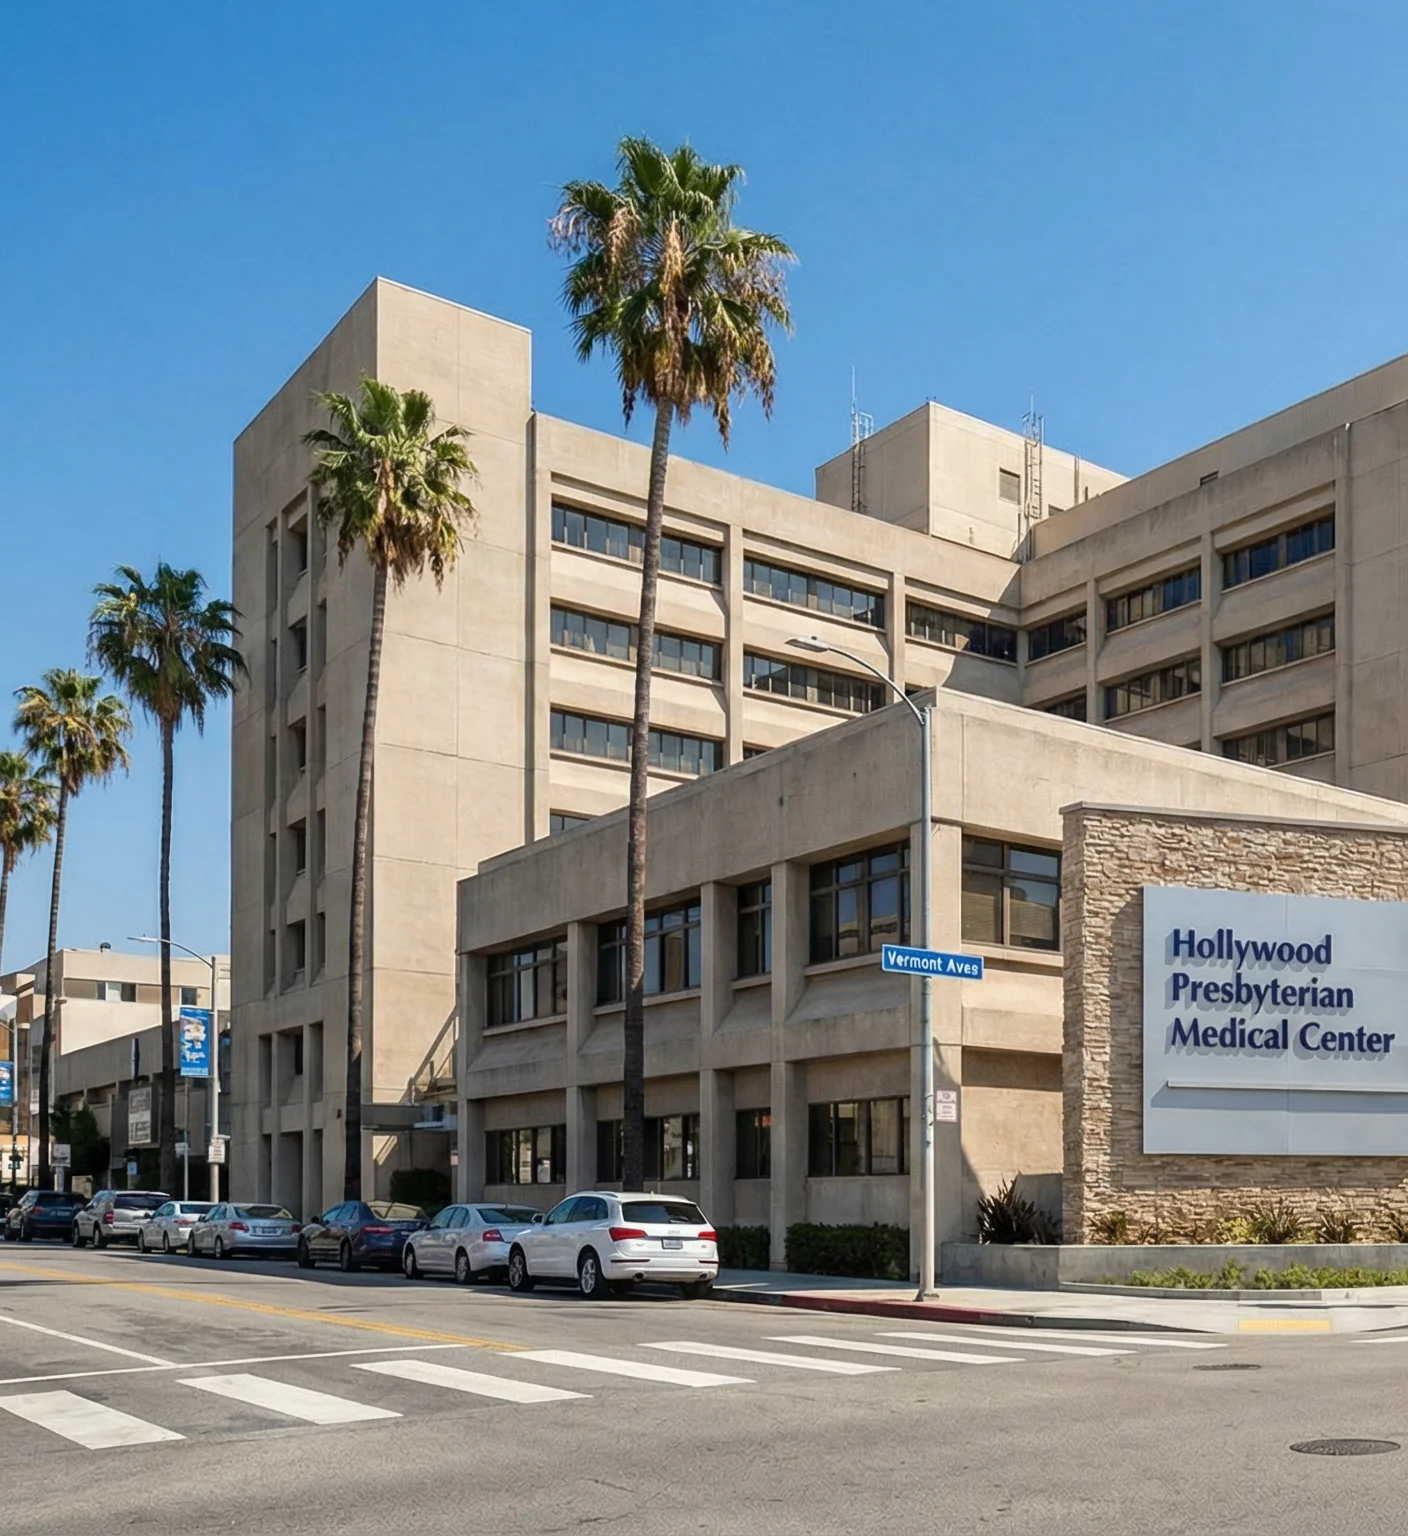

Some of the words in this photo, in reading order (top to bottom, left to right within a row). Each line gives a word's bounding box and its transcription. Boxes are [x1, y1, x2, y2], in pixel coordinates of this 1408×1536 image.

[887, 950, 943, 972] Vermont
[946, 958, 979, 976] Aves
[1172, 928, 1332, 970] Hollywood
[1171, 972, 1354, 1015] Presbyterian
[1170, 1017, 1289, 1050] Medical
[1299, 1022, 1396, 1053] Center
